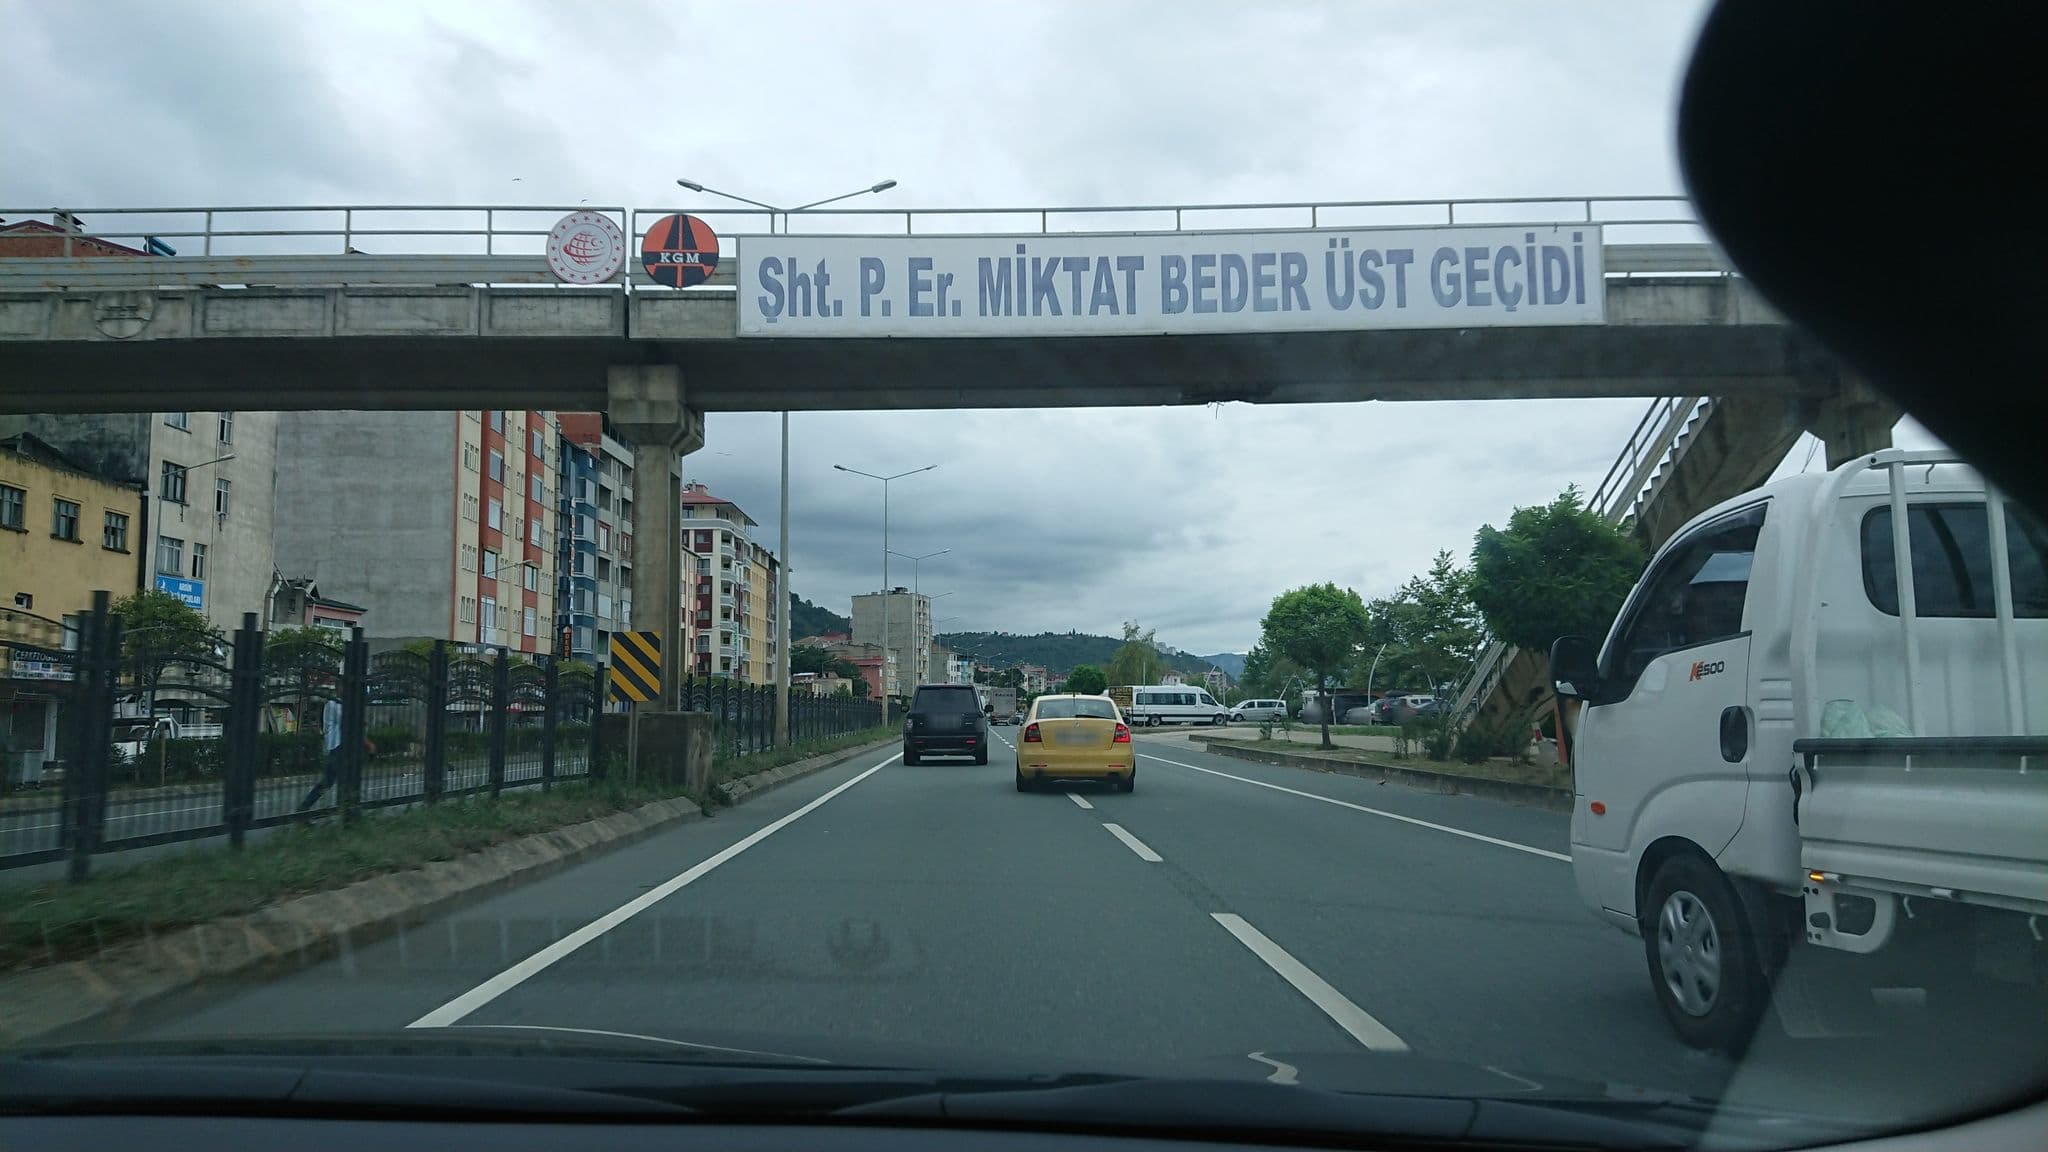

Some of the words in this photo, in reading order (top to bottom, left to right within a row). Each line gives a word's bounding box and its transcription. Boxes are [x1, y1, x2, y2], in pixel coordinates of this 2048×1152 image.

[660, 252, 700, 264] KGM
[757, 256, 831, 324] Şht.
[859, 256, 892, 318] P.
[907, 256, 962, 318] Er.
[977, 243, 1145, 318] MİKTAT
[1160, 251, 1312, 316] BEDER
[1324, 237, 1415, 312] ÜST
[1429, 232, 1587, 313] GEÇİDİ
[1689, 661, 1725, 681] K2500
